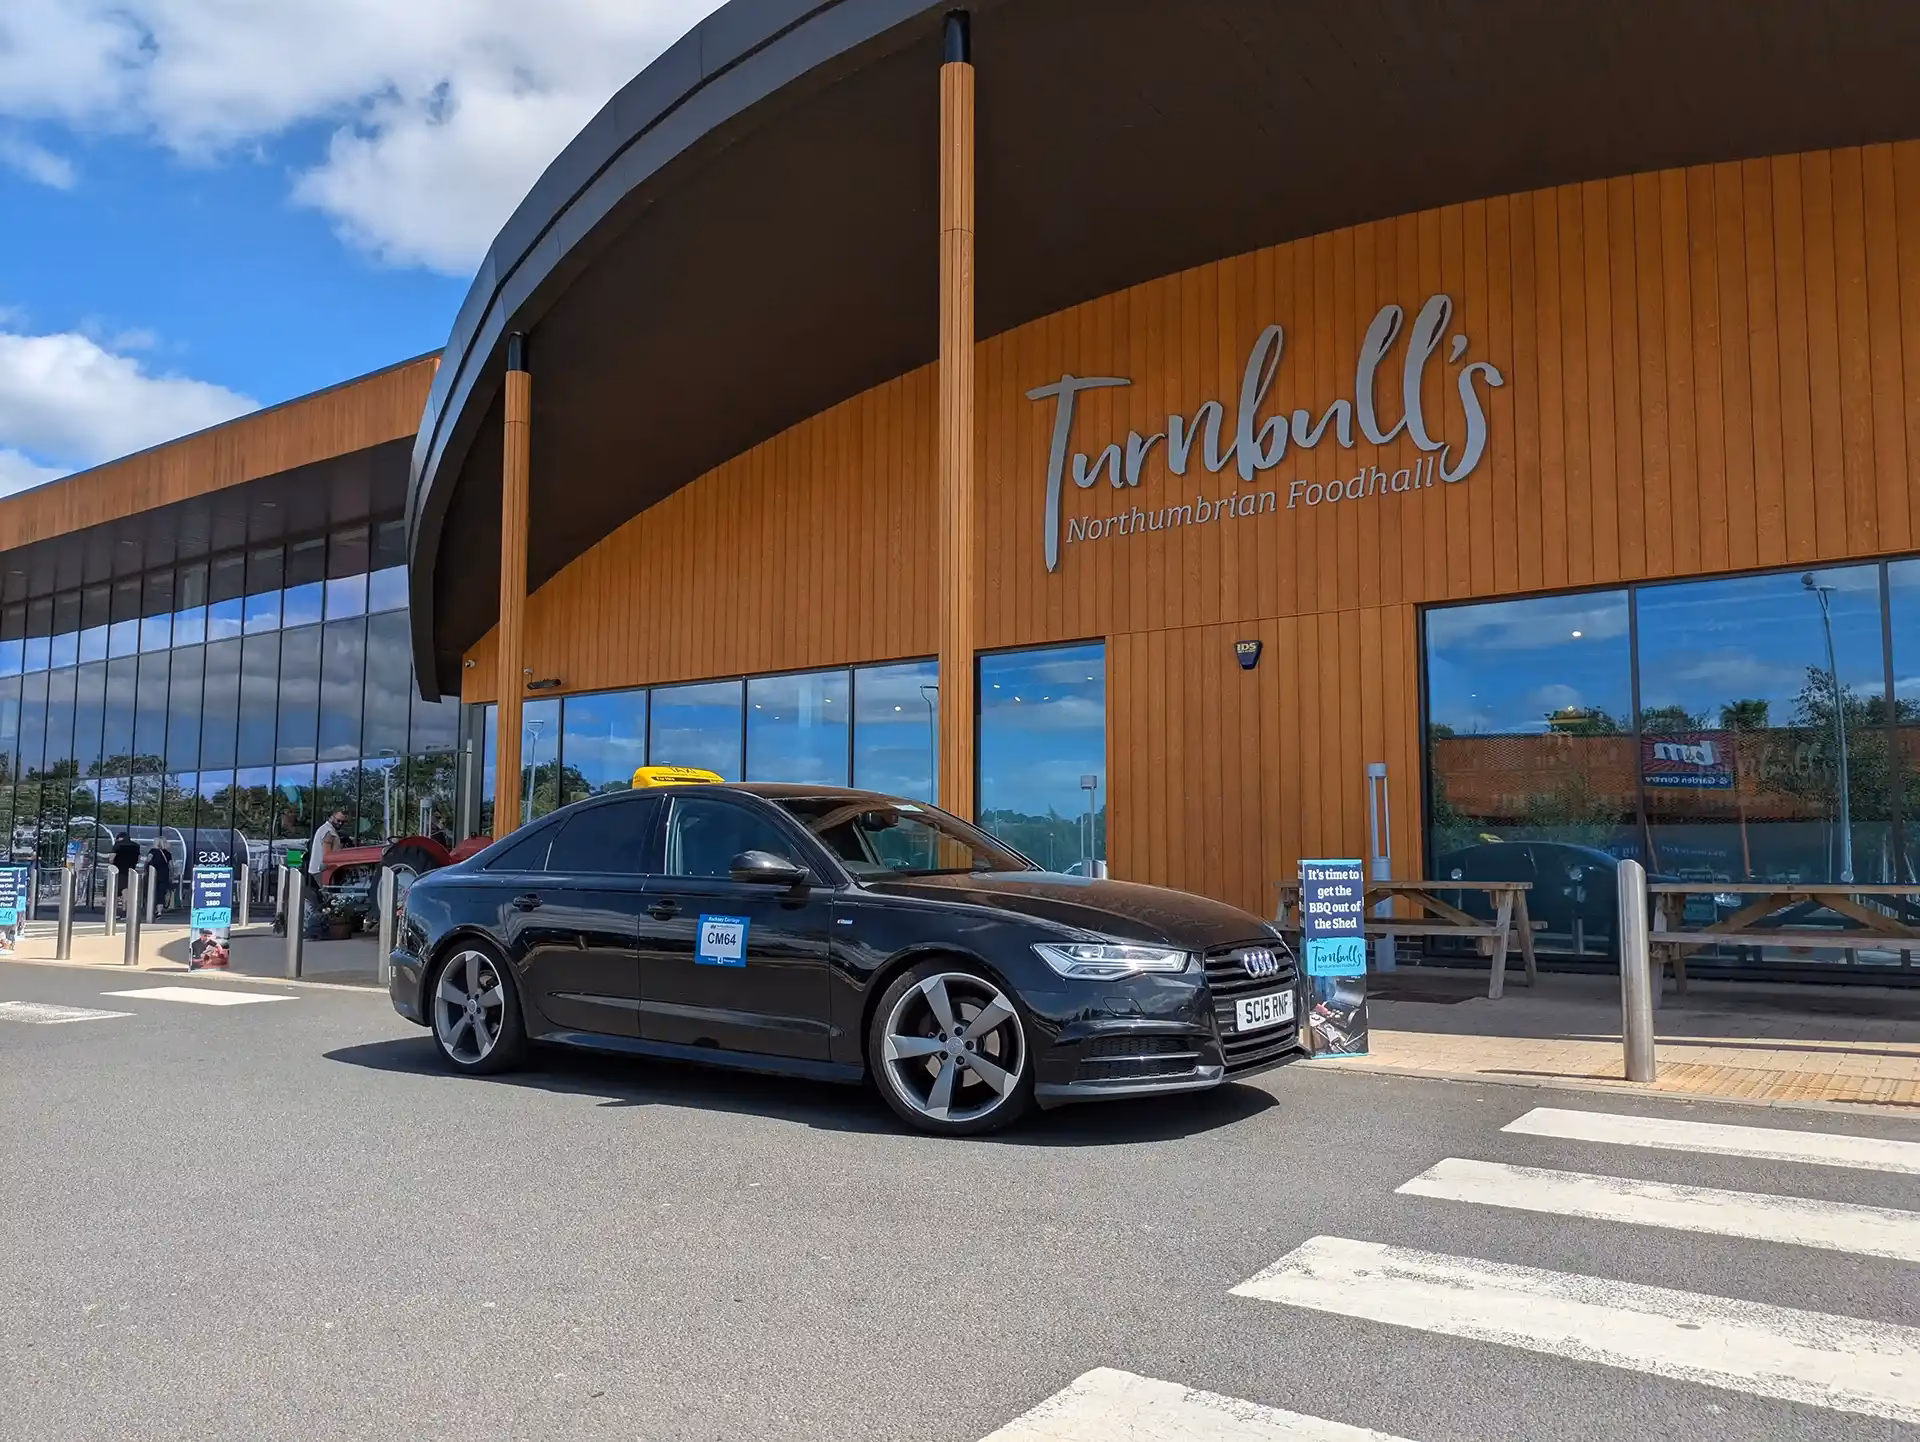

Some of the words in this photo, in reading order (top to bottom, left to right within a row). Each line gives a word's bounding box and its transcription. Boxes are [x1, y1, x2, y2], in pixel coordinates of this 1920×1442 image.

[1025, 294, 1503, 573] Turnbull's
[1066, 490, 1276, 544] Northumbrian
[1286, 457, 1434, 510] Foodhall
[1307, 869, 1325, 880] It's
[1325, 868, 1348, 880] time
[1349, 870, 1360, 880] to
[1317, 886, 1334, 899] get
[1335, 885, 1352, 896] the
[1309, 902, 1332, 915] BBQ
[1332, 902, 1349, 913] out
[1350, 900, 1362, 912] of
[1314, 918, 1331, 929] the
[1332, 917, 1357, 929] Shed
[707, 932, 737, 946] CM64
[1245, 998, 1271, 1024] SC15
[1272, 993, 1288, 1017] RNF
